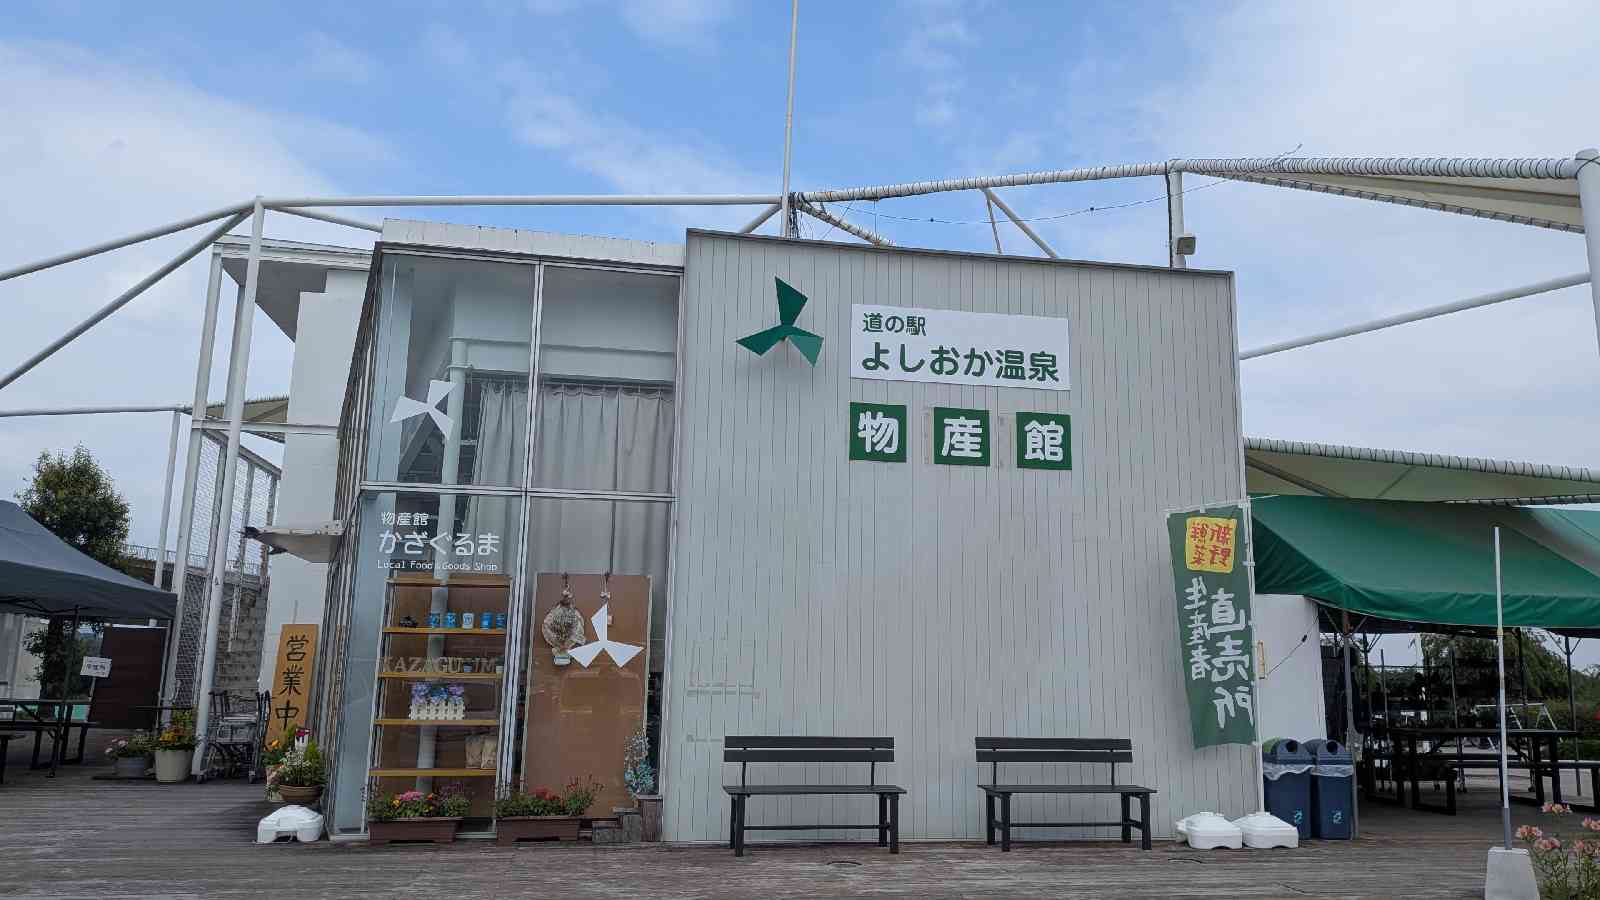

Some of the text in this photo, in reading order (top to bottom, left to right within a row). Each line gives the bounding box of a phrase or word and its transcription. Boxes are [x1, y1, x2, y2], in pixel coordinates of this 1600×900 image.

[863, 312, 927, 336] 道の駅
[862, 342, 1059, 382] よしおか温泉
[857, 411, 1065, 462] 物産館
[382, 512, 429, 526] 物産館
[379, 530, 500, 556] かざぐるま
[377, 560, 405, 569] Local
[410, 561, 433, 569] Food
[474, 562, 498, 571] Shop
[275, 635, 310, 730] 営業中
